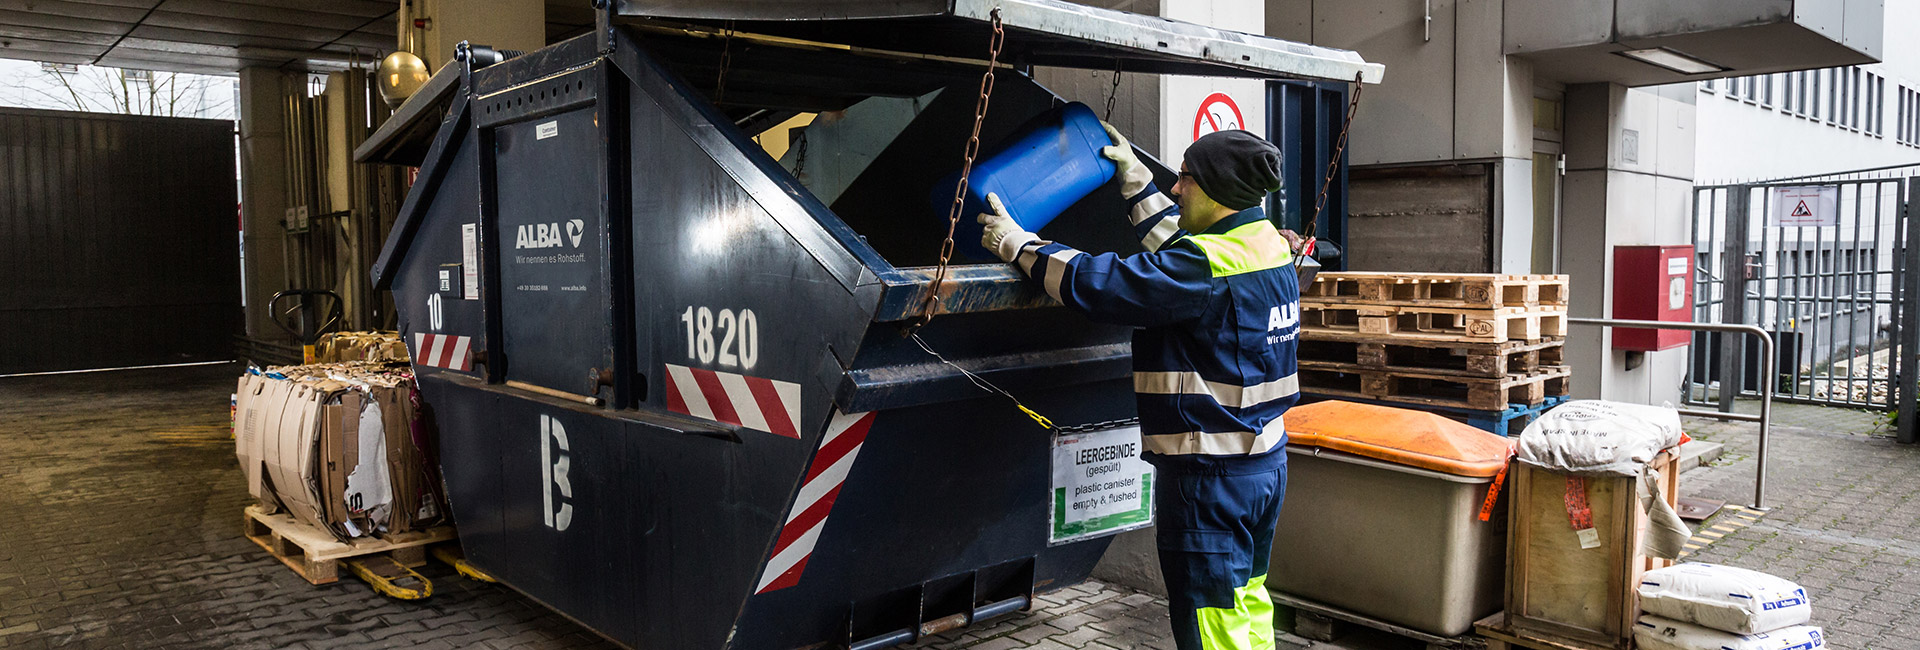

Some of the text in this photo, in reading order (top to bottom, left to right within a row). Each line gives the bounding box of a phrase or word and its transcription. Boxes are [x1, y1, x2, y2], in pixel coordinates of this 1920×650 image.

[515, 222, 563, 249] ALBA
[516, 253, 586, 264] Wir nennen es Rohstoff.
[427, 292, 443, 331] 10
[681, 305, 758, 370] 1820
[1266, 334, 1280, 345] Wir
[1075, 443, 1136, 465] LEERGEBINDE
[540, 414, 573, 532] B
[1085, 462, 1121, 478] (gespült)
[1075, 477, 1135, 497] plastic canister
[1072, 490, 1137, 511] empty & flushed
